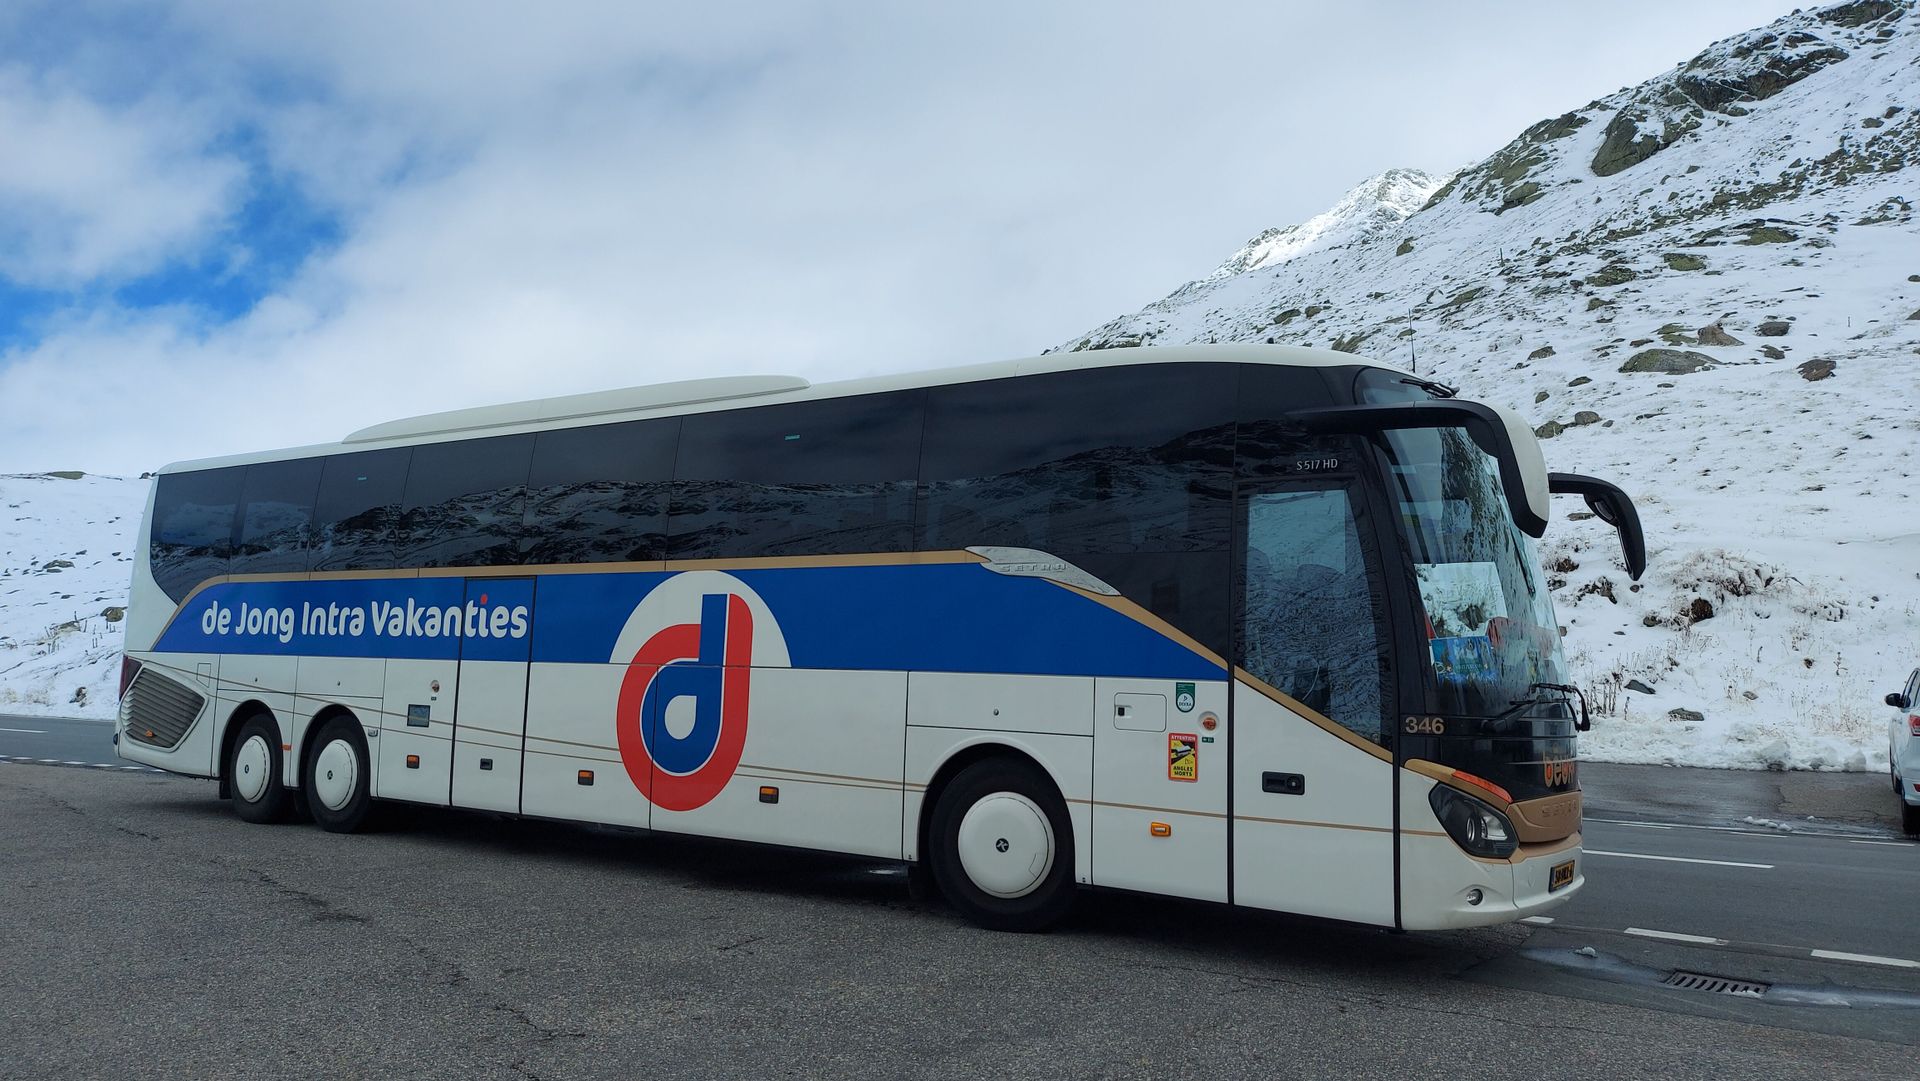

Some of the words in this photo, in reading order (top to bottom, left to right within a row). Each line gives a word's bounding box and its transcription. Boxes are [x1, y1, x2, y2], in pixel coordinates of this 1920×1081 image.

[1296, 461, 1303, 471] S
[1304, 460, 1320, 470] 517
[1323, 459, 1338, 469] HD
[1000, 563, 1067, 573] SETRA
[202, 600, 231, 635] de
[235, 602, 295, 643] Jong
[302, 601, 365, 636] Intra
[371, 594, 528, 639] Vakanties
[1405, 717, 1445, 735] 346
